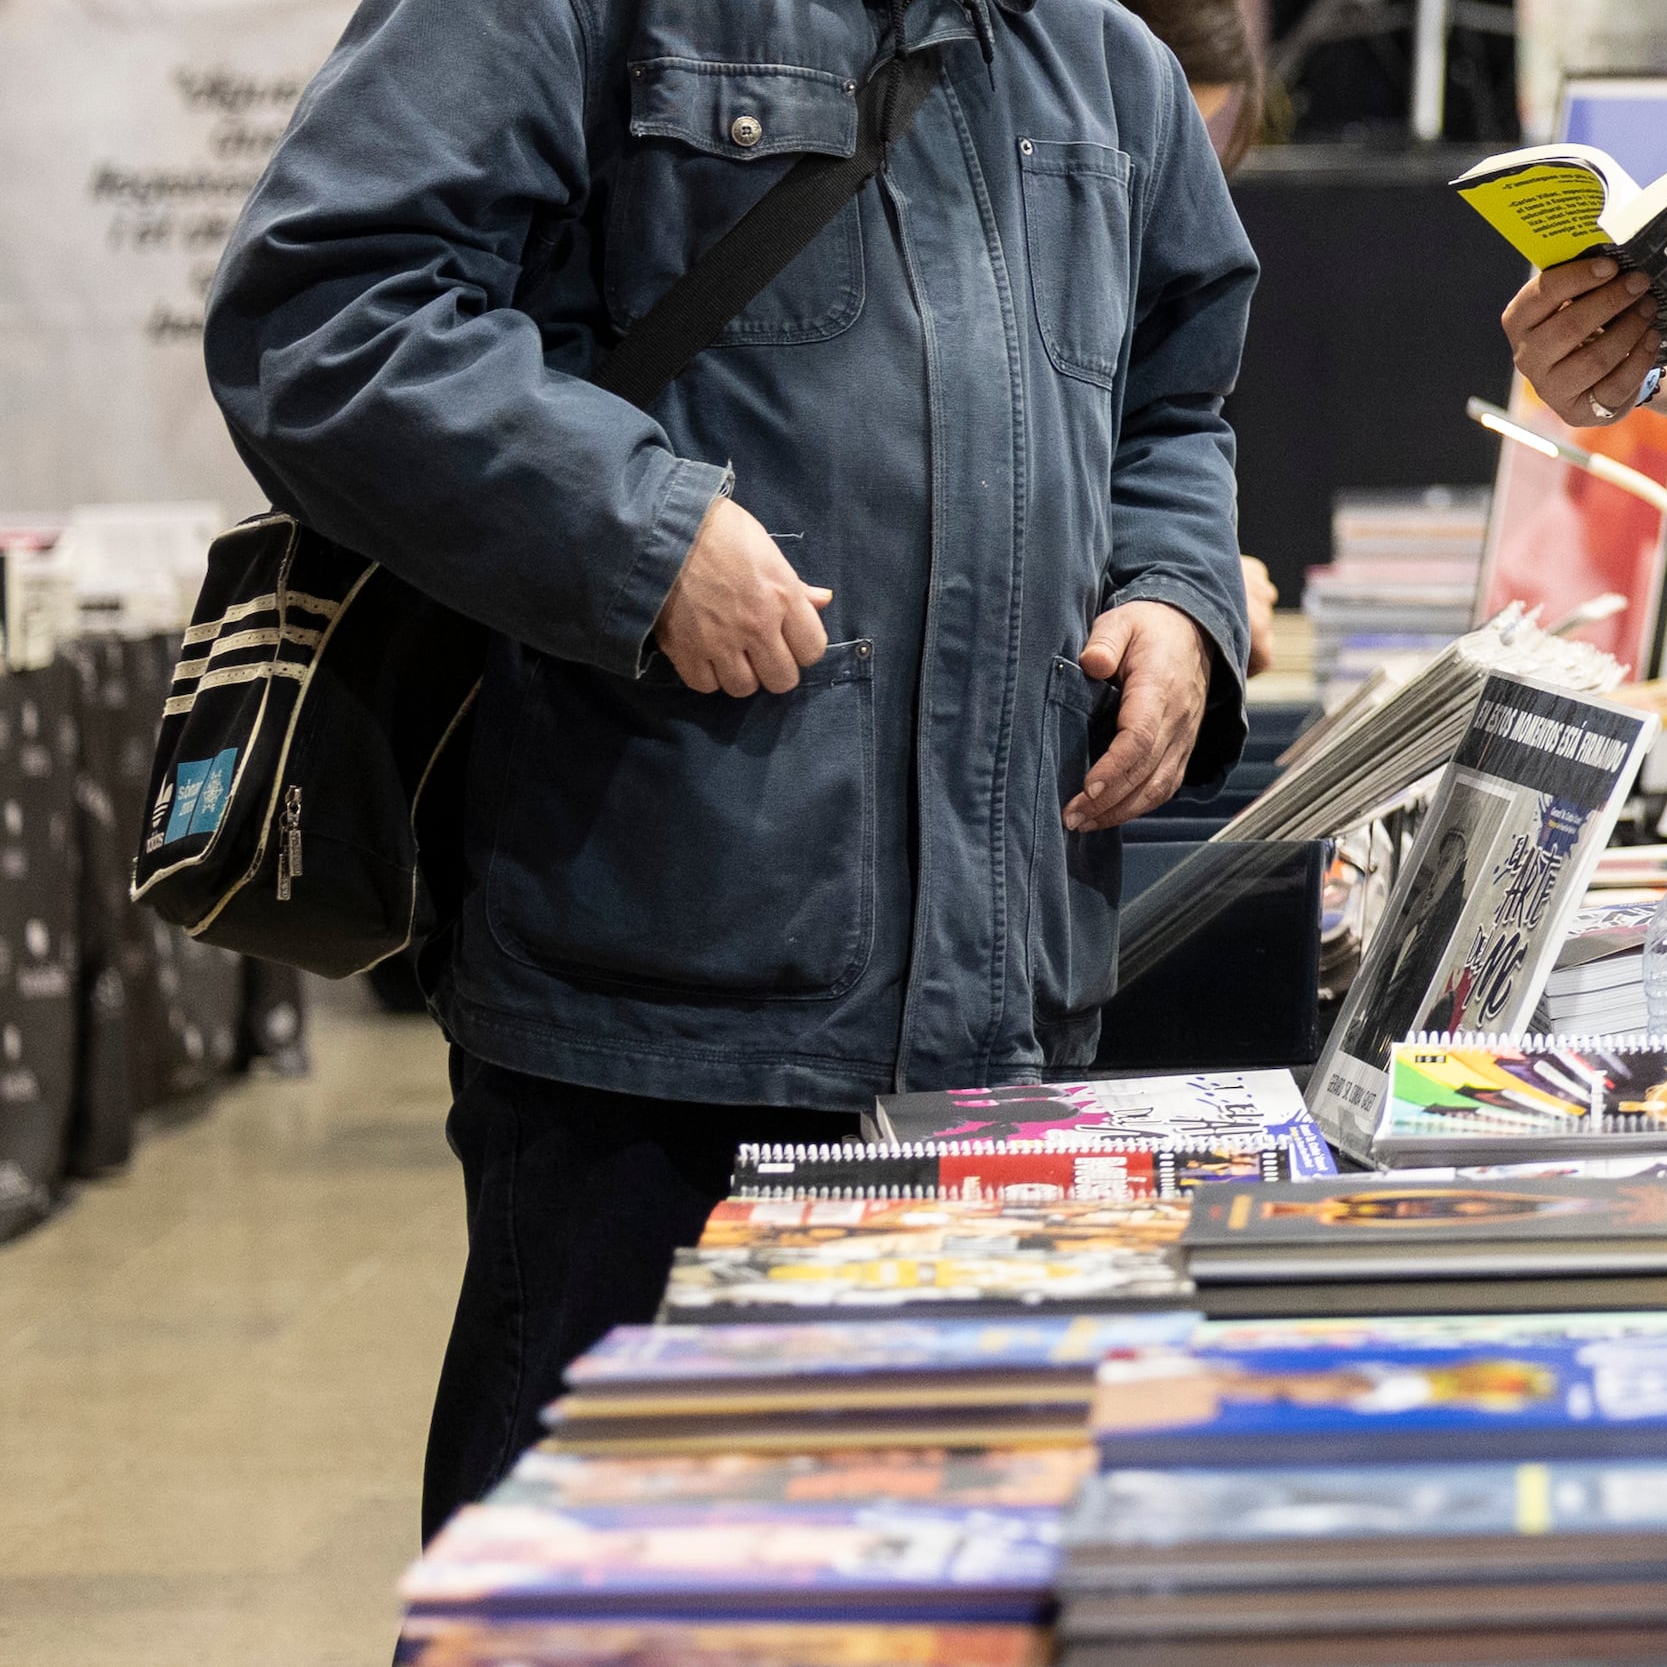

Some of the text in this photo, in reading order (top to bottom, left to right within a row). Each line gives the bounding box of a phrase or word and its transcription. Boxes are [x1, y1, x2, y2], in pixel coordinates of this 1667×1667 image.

[1473, 700, 1629, 773] EN ESTOS MOMENTOS ESTÁ FIRMANDO
